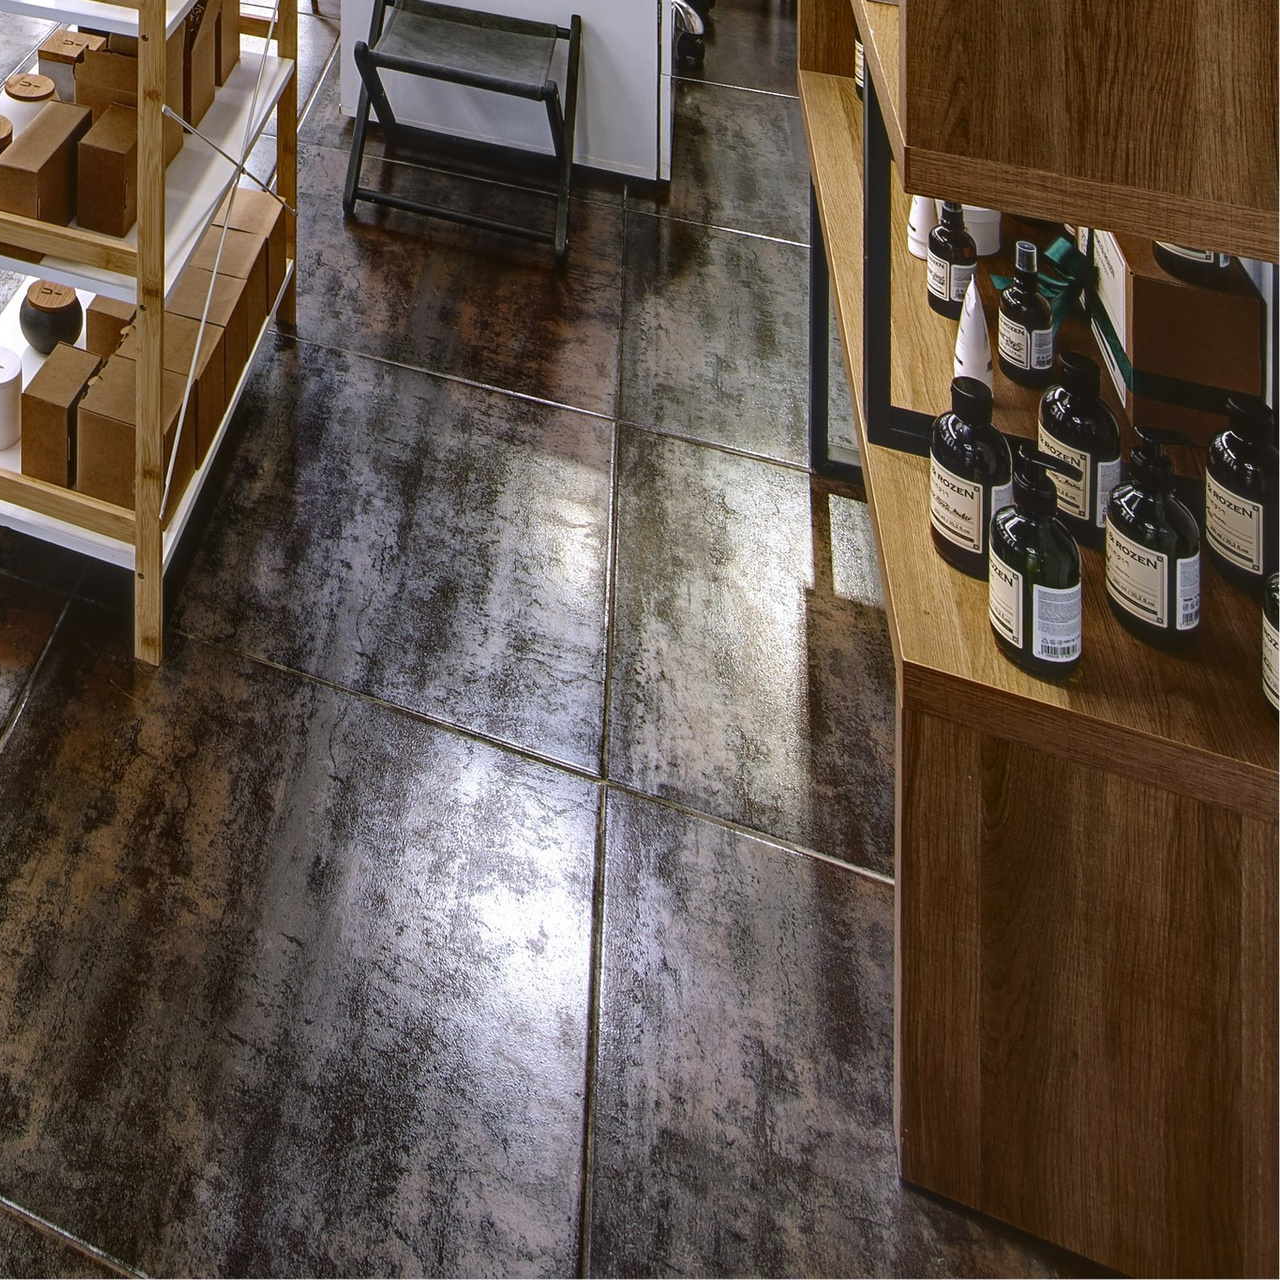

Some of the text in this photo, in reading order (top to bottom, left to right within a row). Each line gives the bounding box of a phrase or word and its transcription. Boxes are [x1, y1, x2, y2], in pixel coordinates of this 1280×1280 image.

[1005, 320, 1025, 336] ROZEN
[1045, 441, 1081, 467] ROZEN
[937, 473, 974, 500] ROZEN
[1213, 491, 1253, 519] ROZEN
[1116, 541, 1157, 570] ROZEN
